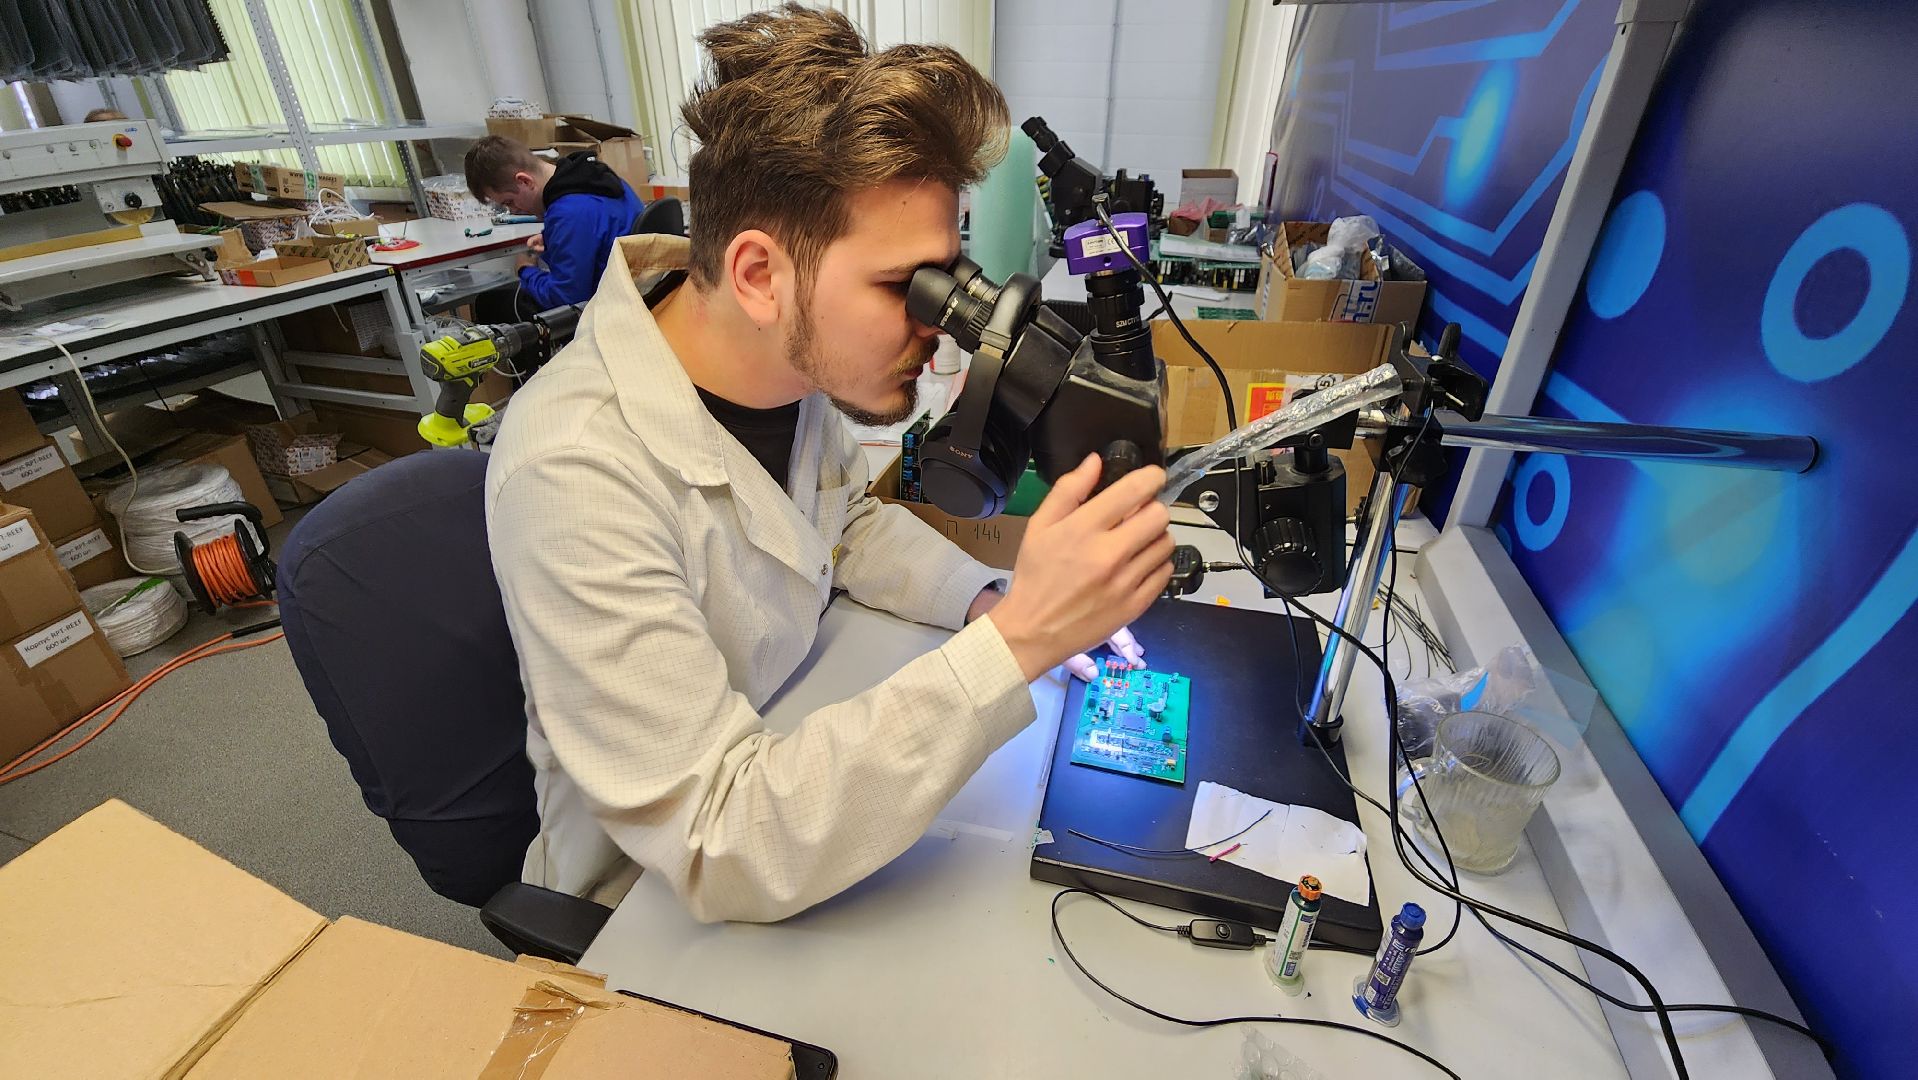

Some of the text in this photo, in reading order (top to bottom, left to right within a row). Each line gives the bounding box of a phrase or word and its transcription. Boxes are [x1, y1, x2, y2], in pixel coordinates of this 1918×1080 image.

[949, 445, 974, 459] SONY
[0, 526, 24, 541] T-REEF
[973, 522, 1001, 545] 144
[24, 619, 83, 652] Корпус RPT-REEF
[45, 640, 60, 652] 600
